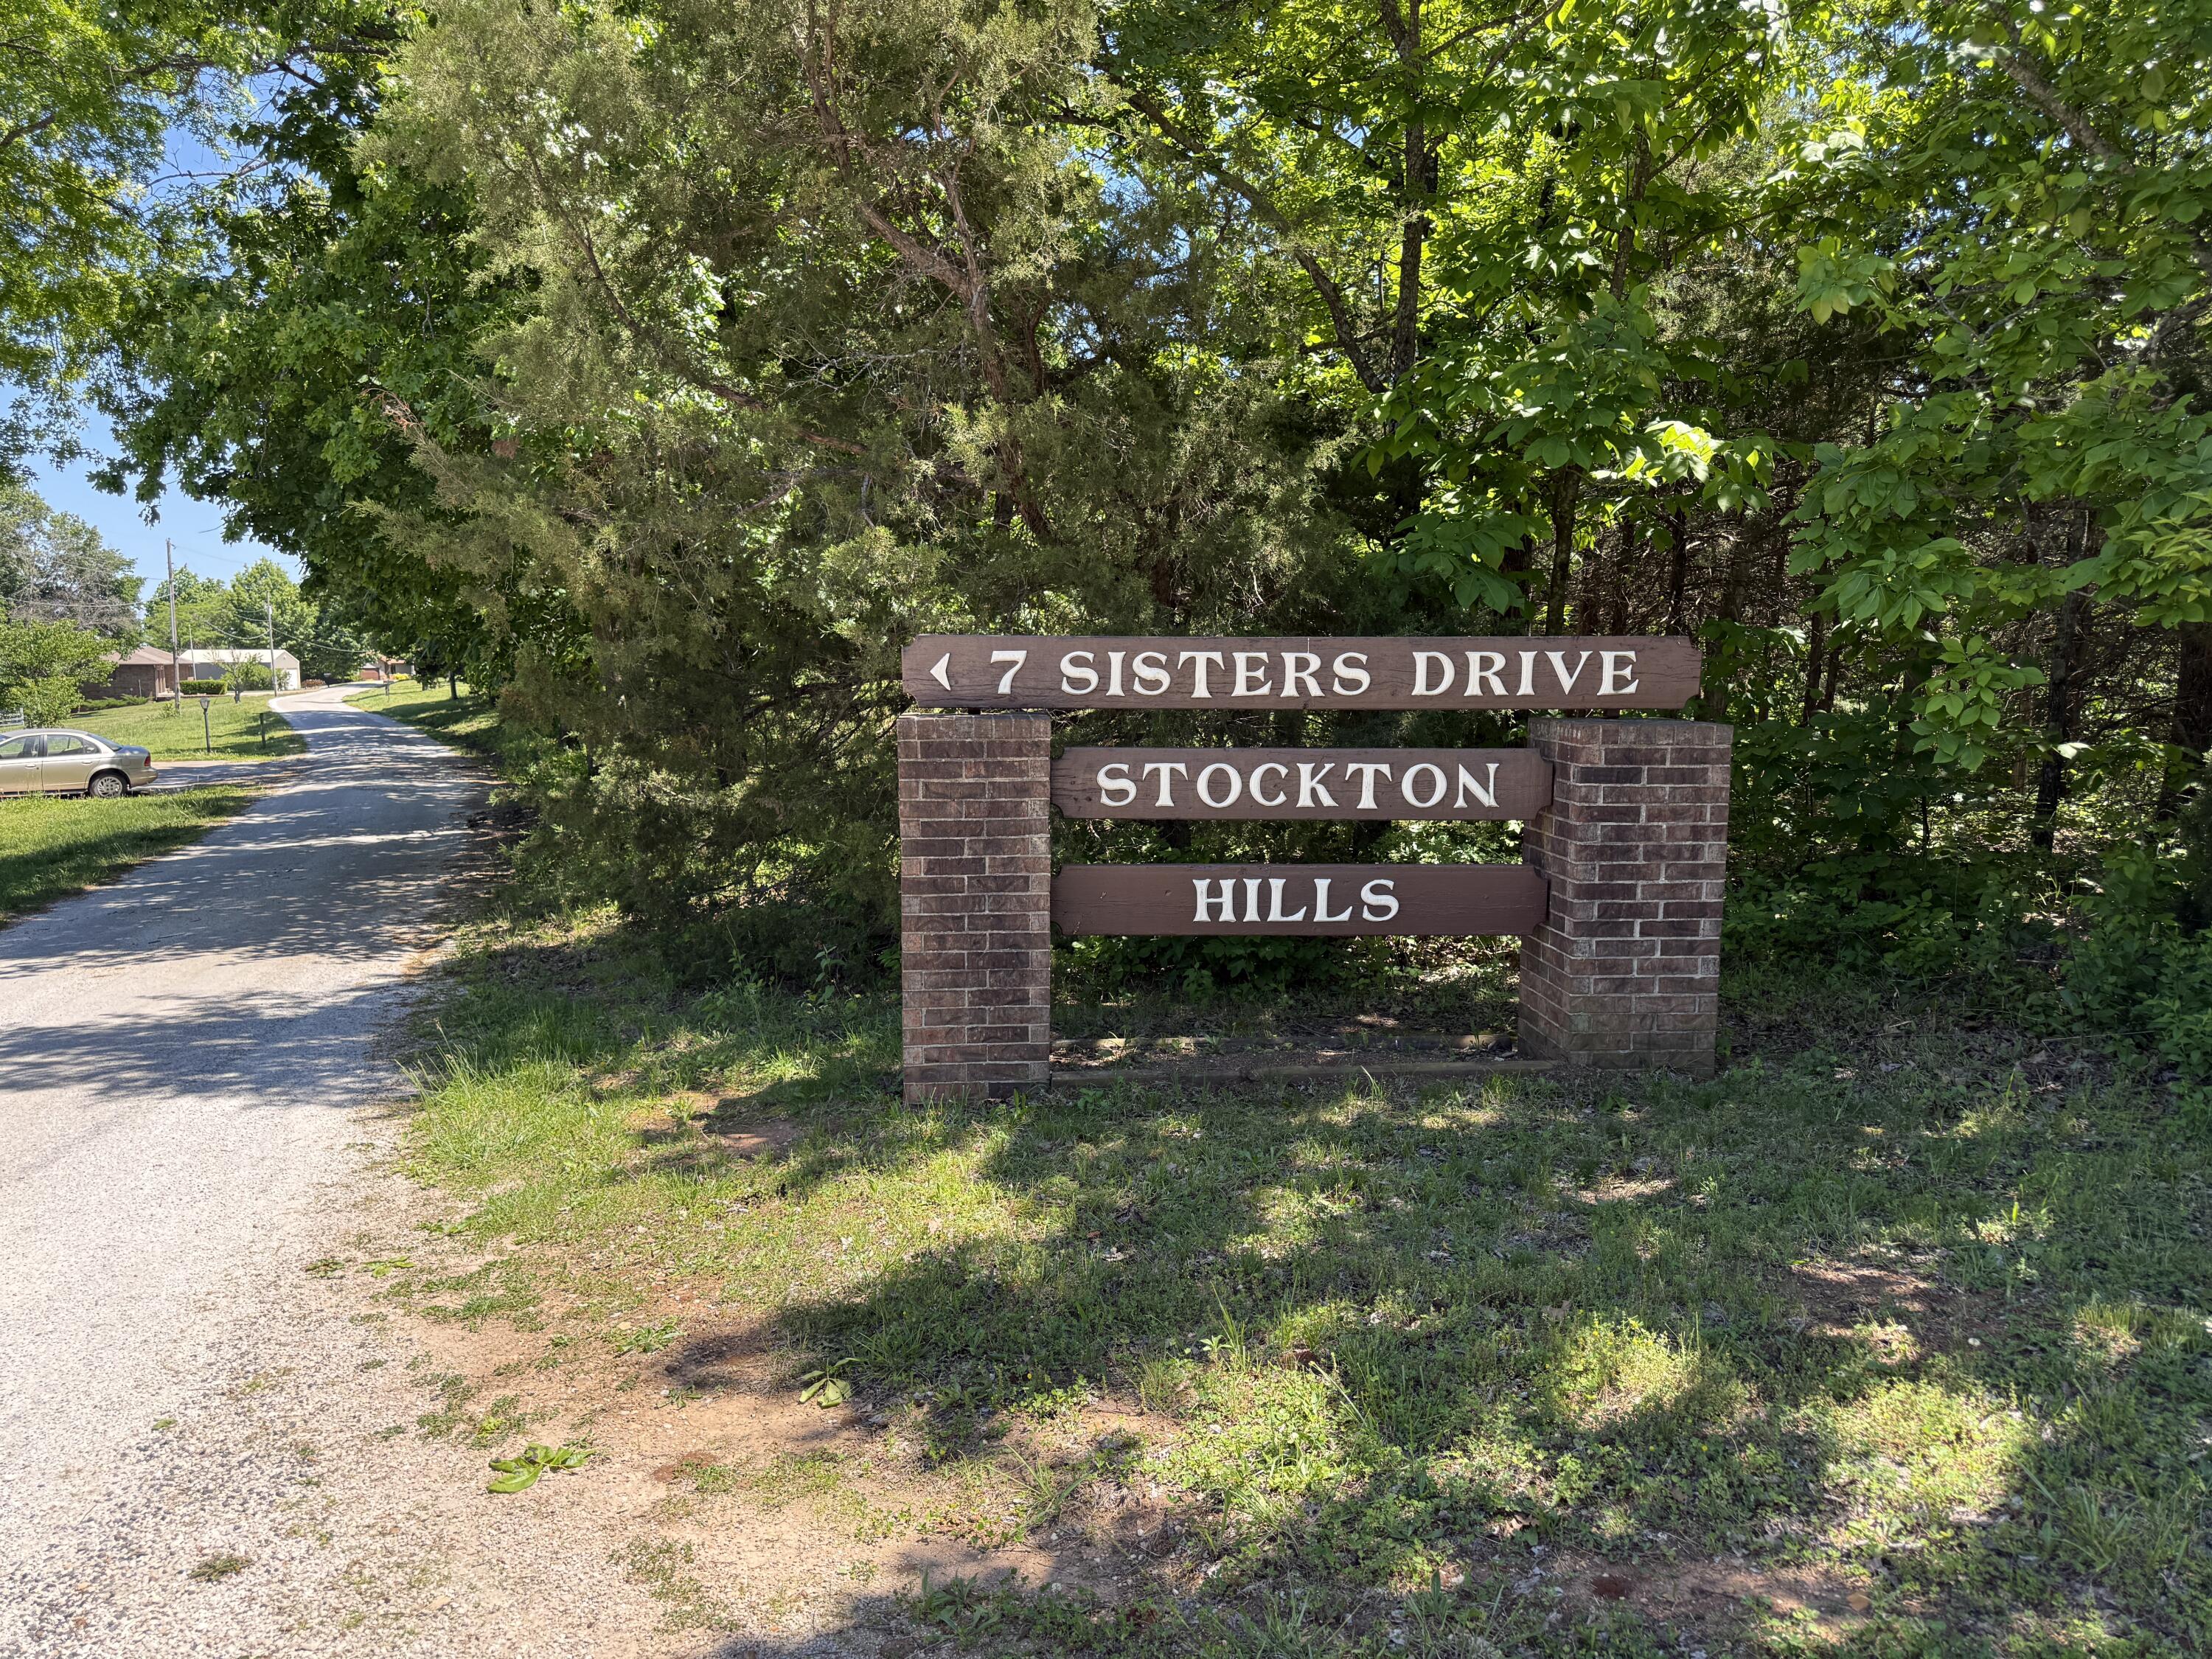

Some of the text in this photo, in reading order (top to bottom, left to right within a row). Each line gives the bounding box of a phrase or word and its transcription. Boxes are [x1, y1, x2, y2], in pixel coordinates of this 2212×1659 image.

[990, 649, 1639, 698] 7 SISTERS DRIVE
[1096, 762, 1500, 809] STOCKTON
[1192, 877, 1400, 923] HILLS
